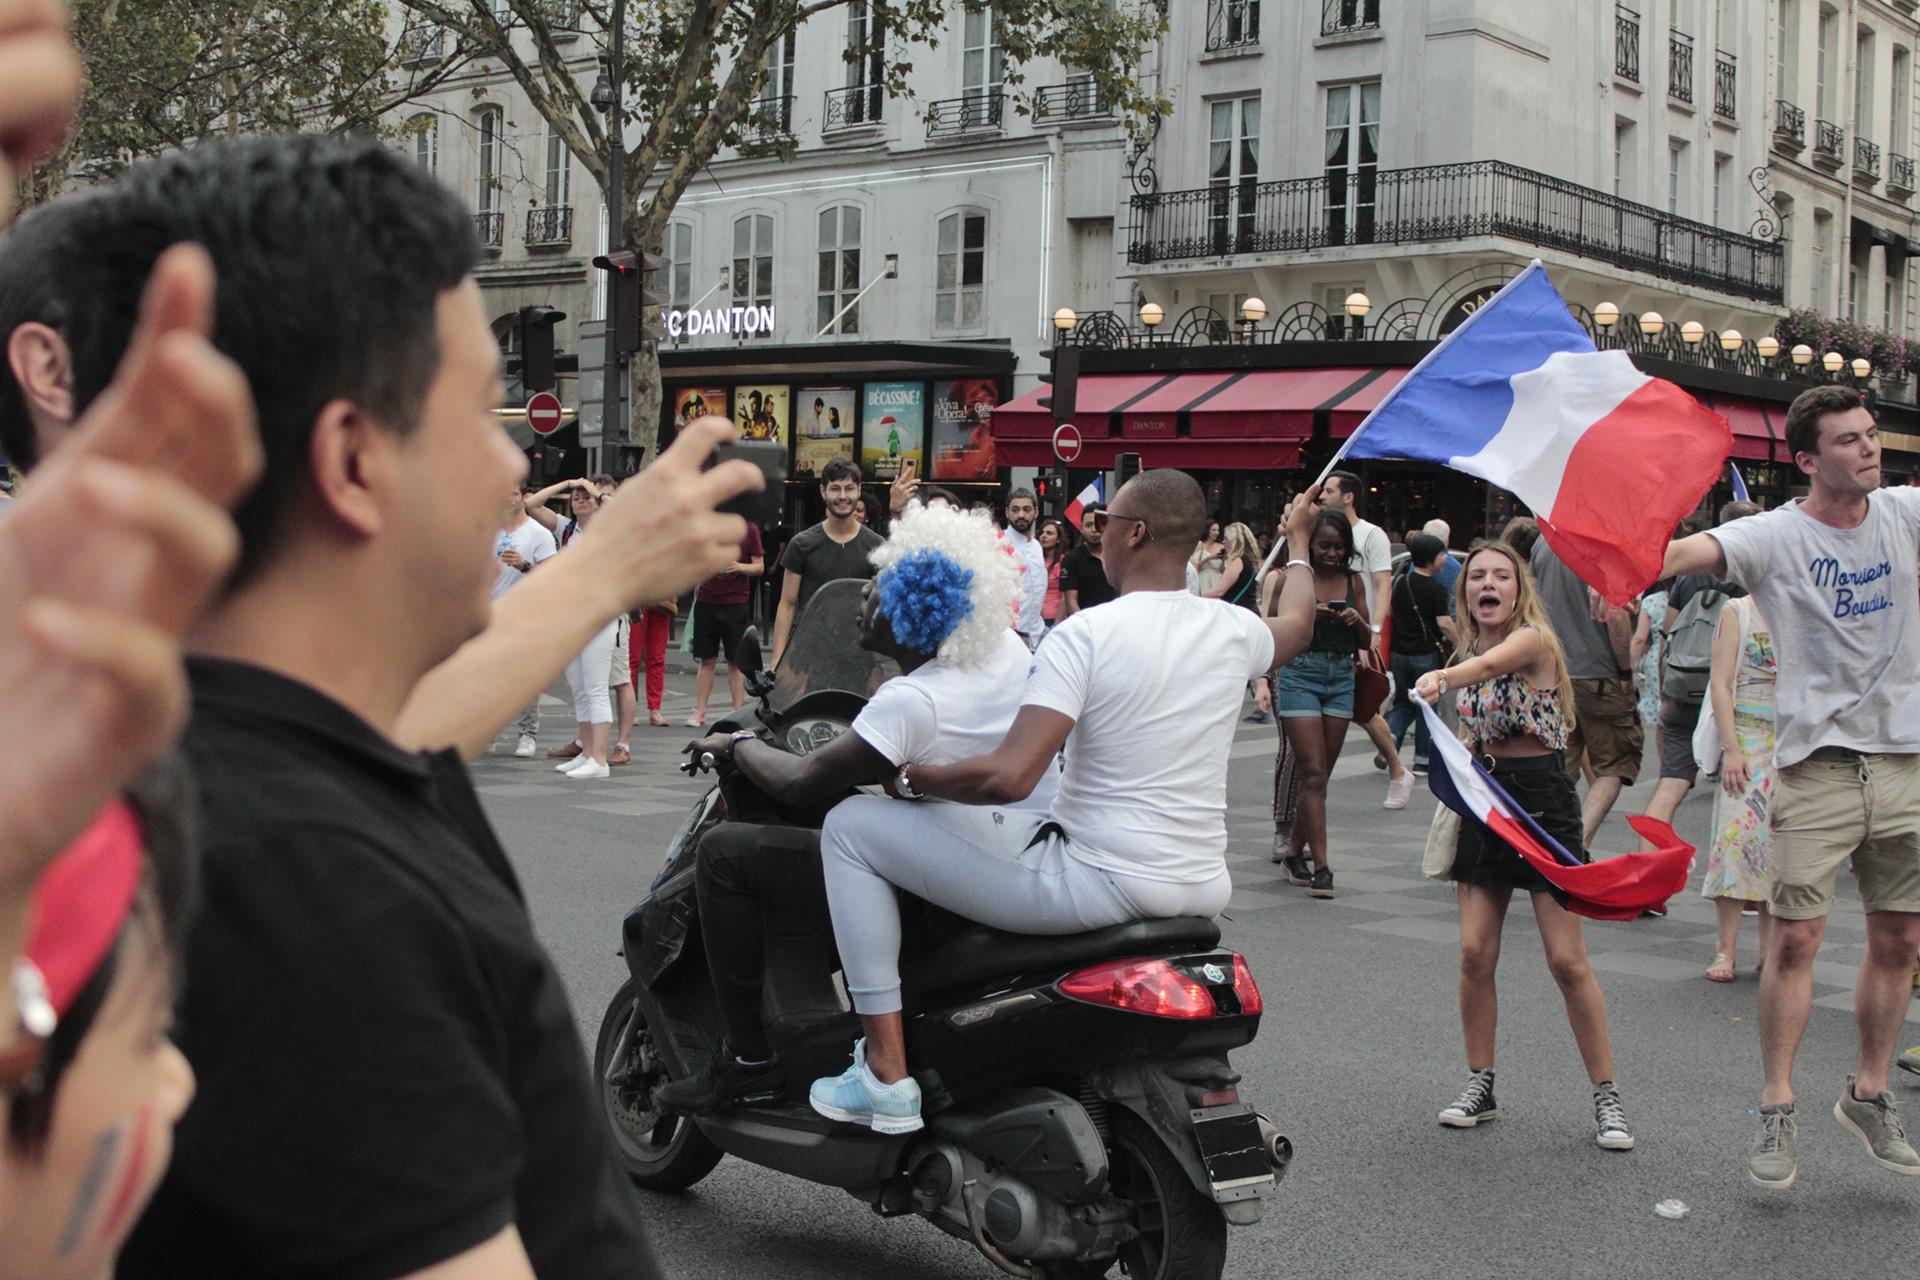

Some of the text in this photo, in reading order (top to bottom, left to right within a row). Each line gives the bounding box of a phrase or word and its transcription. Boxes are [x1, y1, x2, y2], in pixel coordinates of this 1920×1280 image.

[661, 305, 776, 337] C DANTON
[868, 388, 920, 406] BÉCASSINE!
[938, 397, 959, 410] Viva
[1133, 421, 1166, 431] DANTON
[1809, 557, 1892, 587] Monsieur
[1833, 588, 1893, 619] Boudu.
